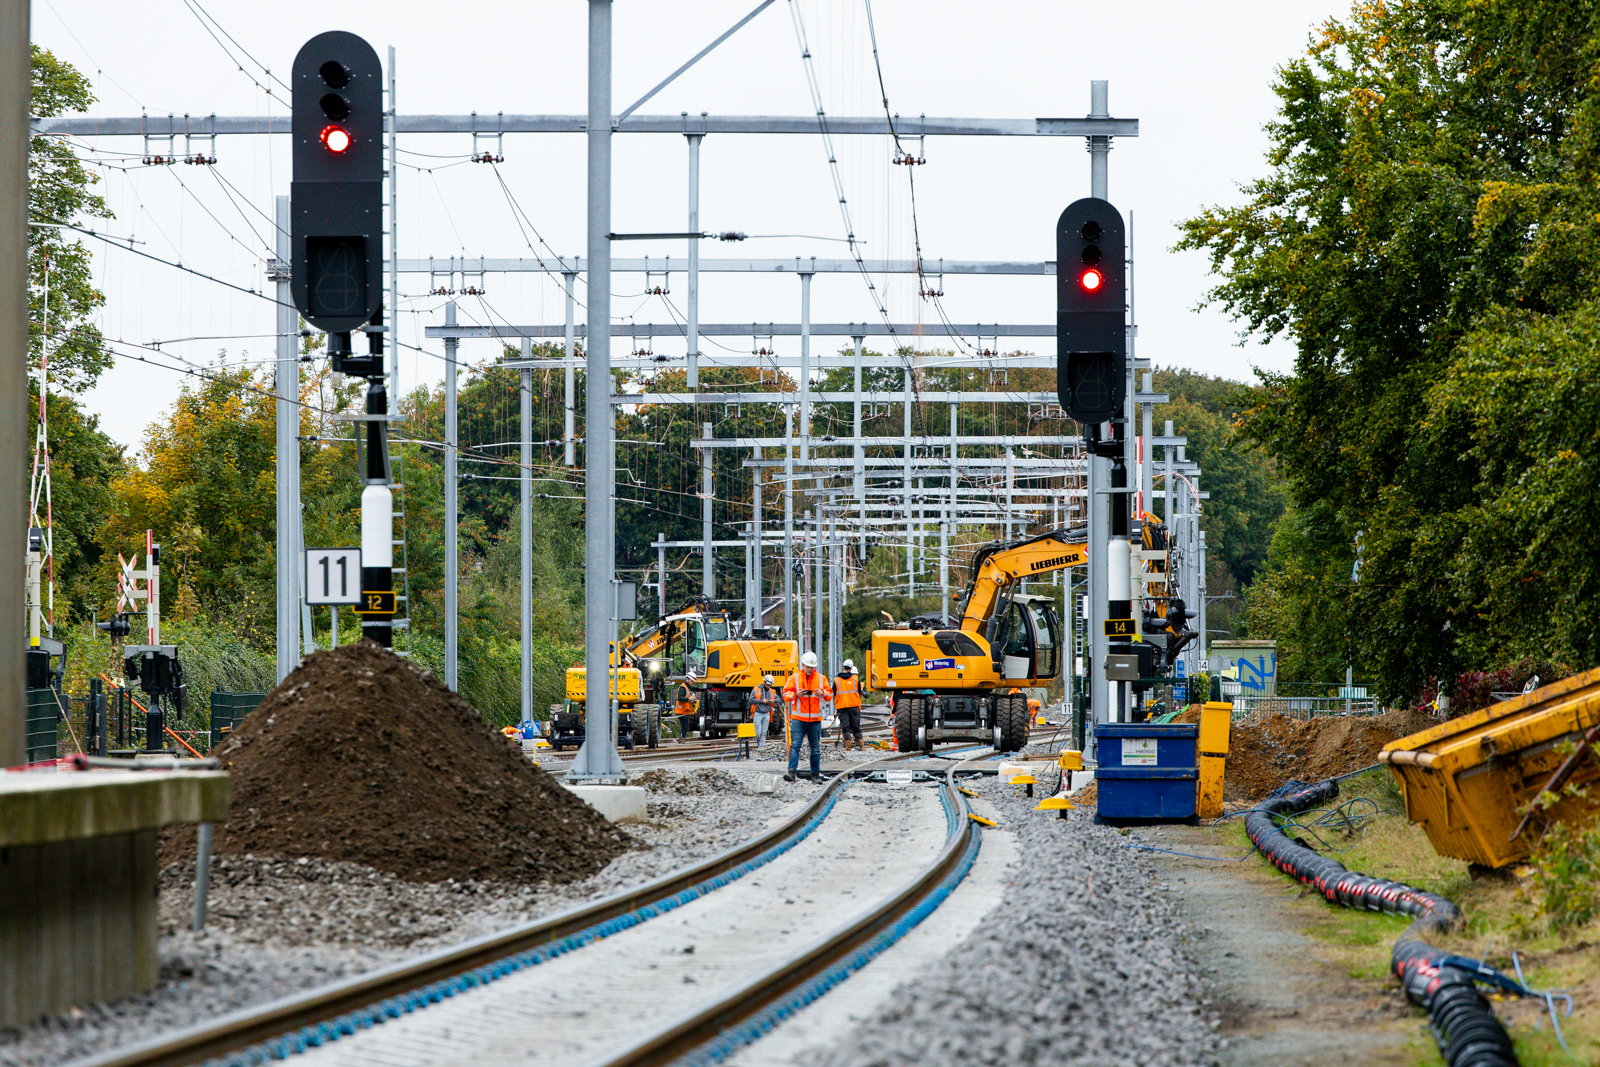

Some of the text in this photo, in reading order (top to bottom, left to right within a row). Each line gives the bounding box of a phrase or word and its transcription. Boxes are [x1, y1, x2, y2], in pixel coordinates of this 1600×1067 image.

[1030, 553, 1079, 571] LIEBHERR
[318, 555, 347, 597] 11
[367, 594, 382, 610] 12
[1114, 621, 1127, 634] 14
[1198, 661, 1208, 670] 14
[1064, 704, 1071, 713] 11
